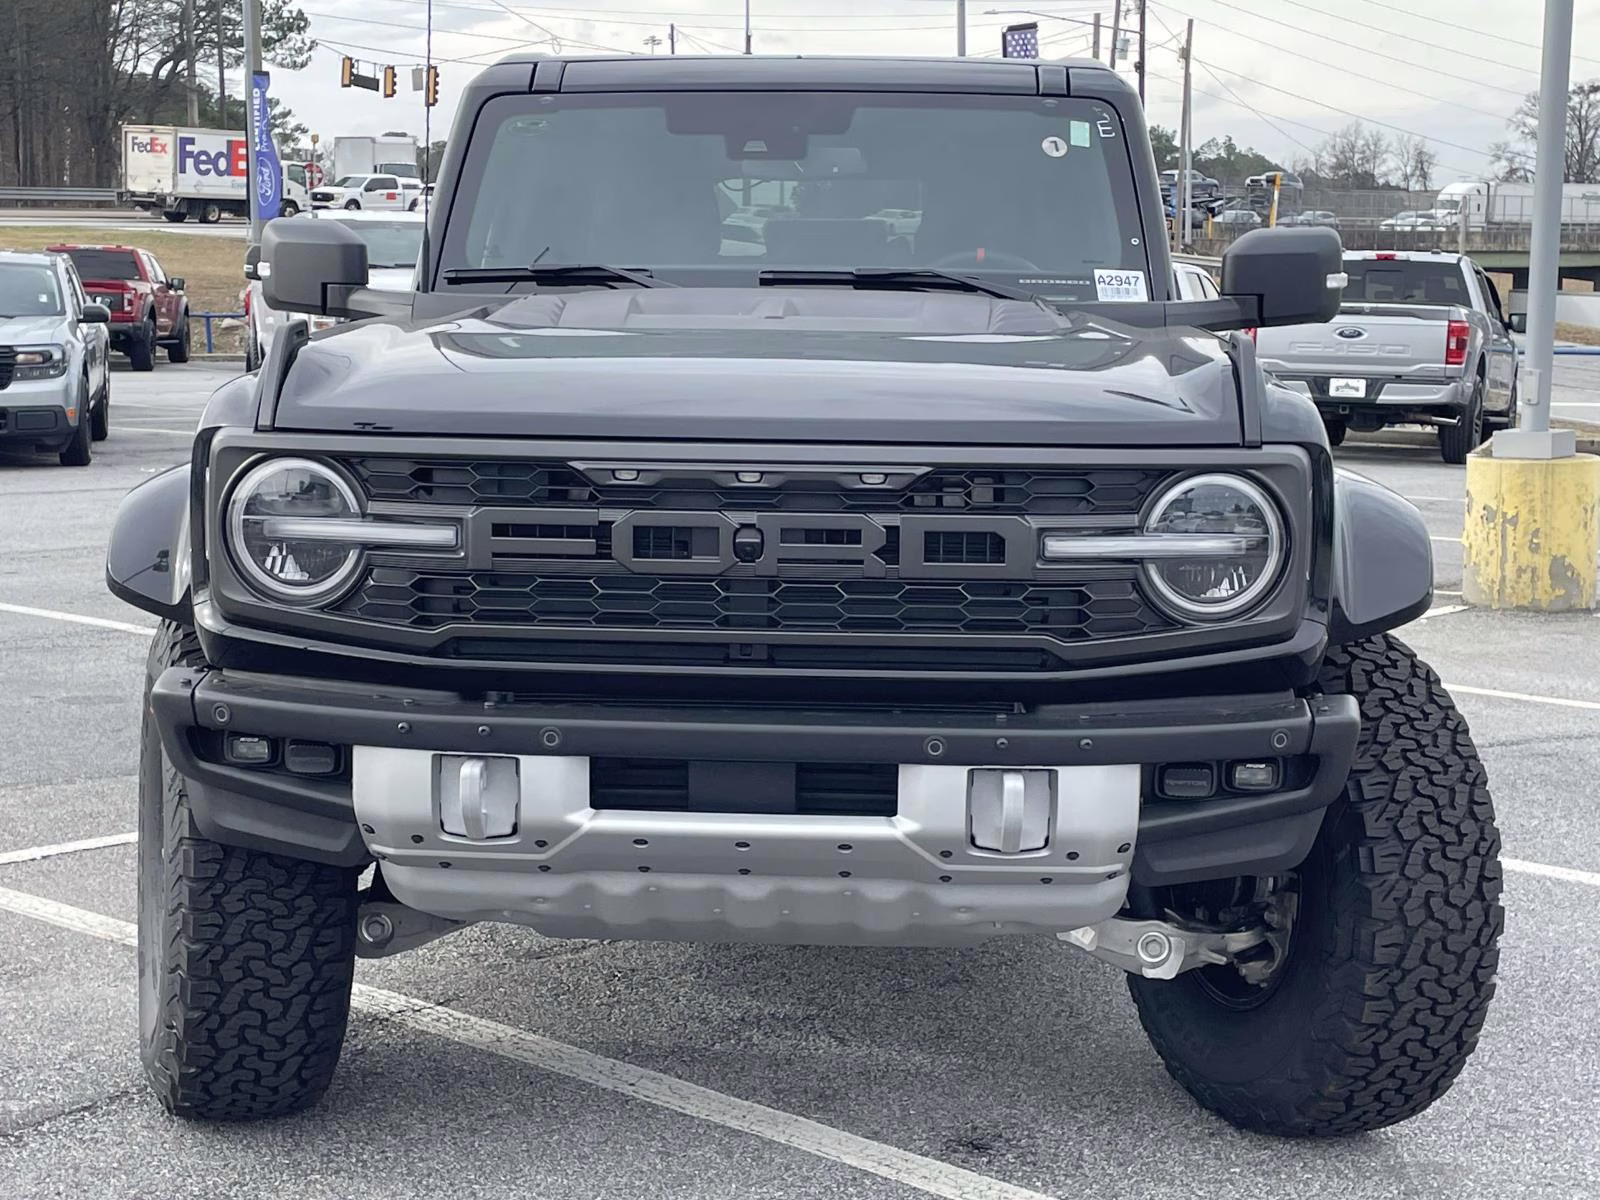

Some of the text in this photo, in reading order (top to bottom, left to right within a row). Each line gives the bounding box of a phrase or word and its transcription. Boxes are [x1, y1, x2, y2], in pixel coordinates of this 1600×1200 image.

[131, 136, 167, 154] FedEx
[179, 136, 248, 177] FedE
[1098, 274, 1140, 287] A2947
[1289, 341, 1411, 356] F-150
[469, 506, 1034, 579] FORD
